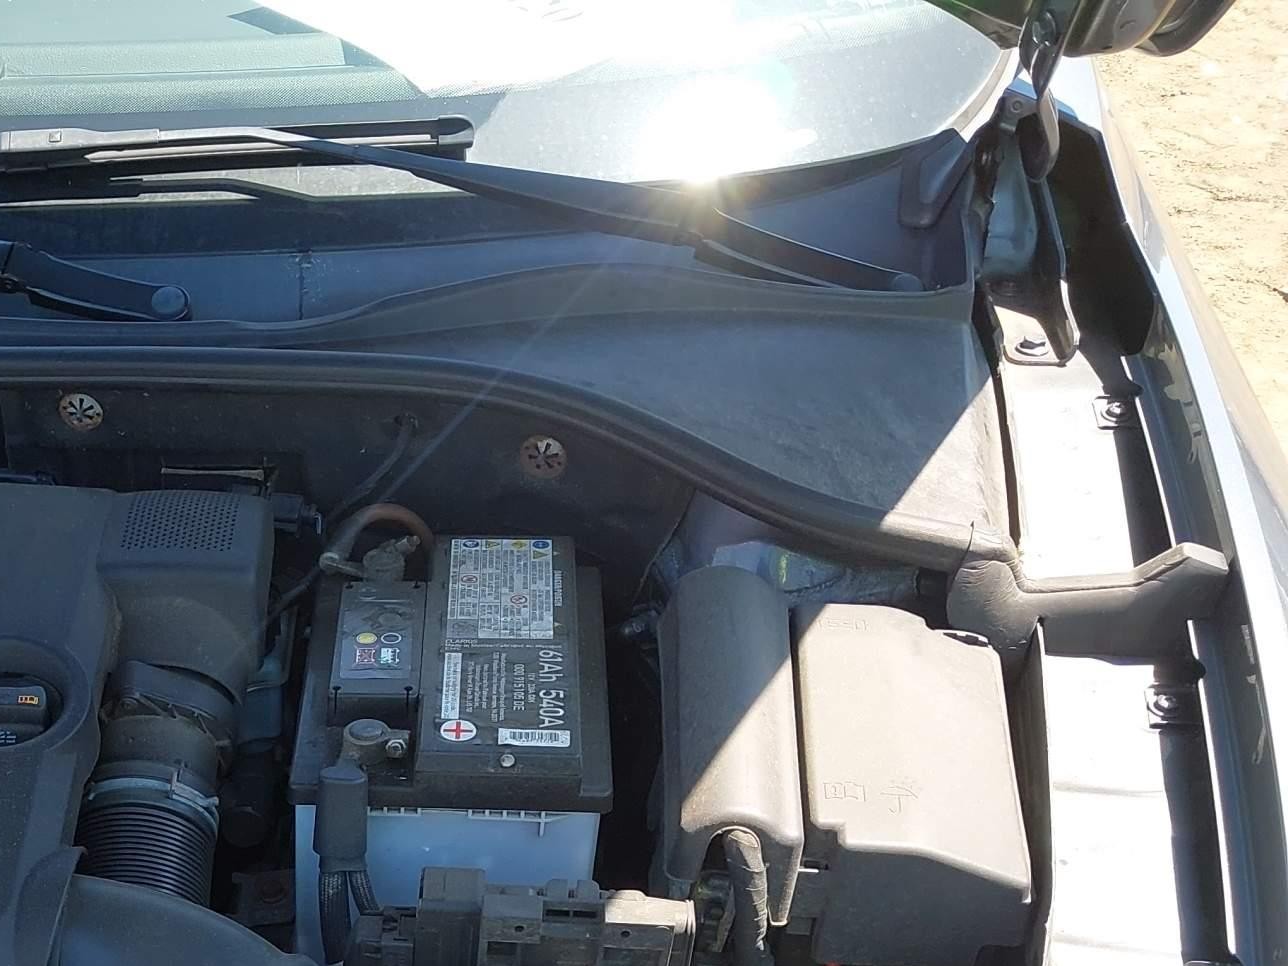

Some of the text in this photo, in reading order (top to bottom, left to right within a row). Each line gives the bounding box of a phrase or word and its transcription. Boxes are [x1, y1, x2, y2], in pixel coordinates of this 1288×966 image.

[513, 663, 525, 711] 000 915 105 DE
[538, 649, 565, 728] 61Ah 540A
